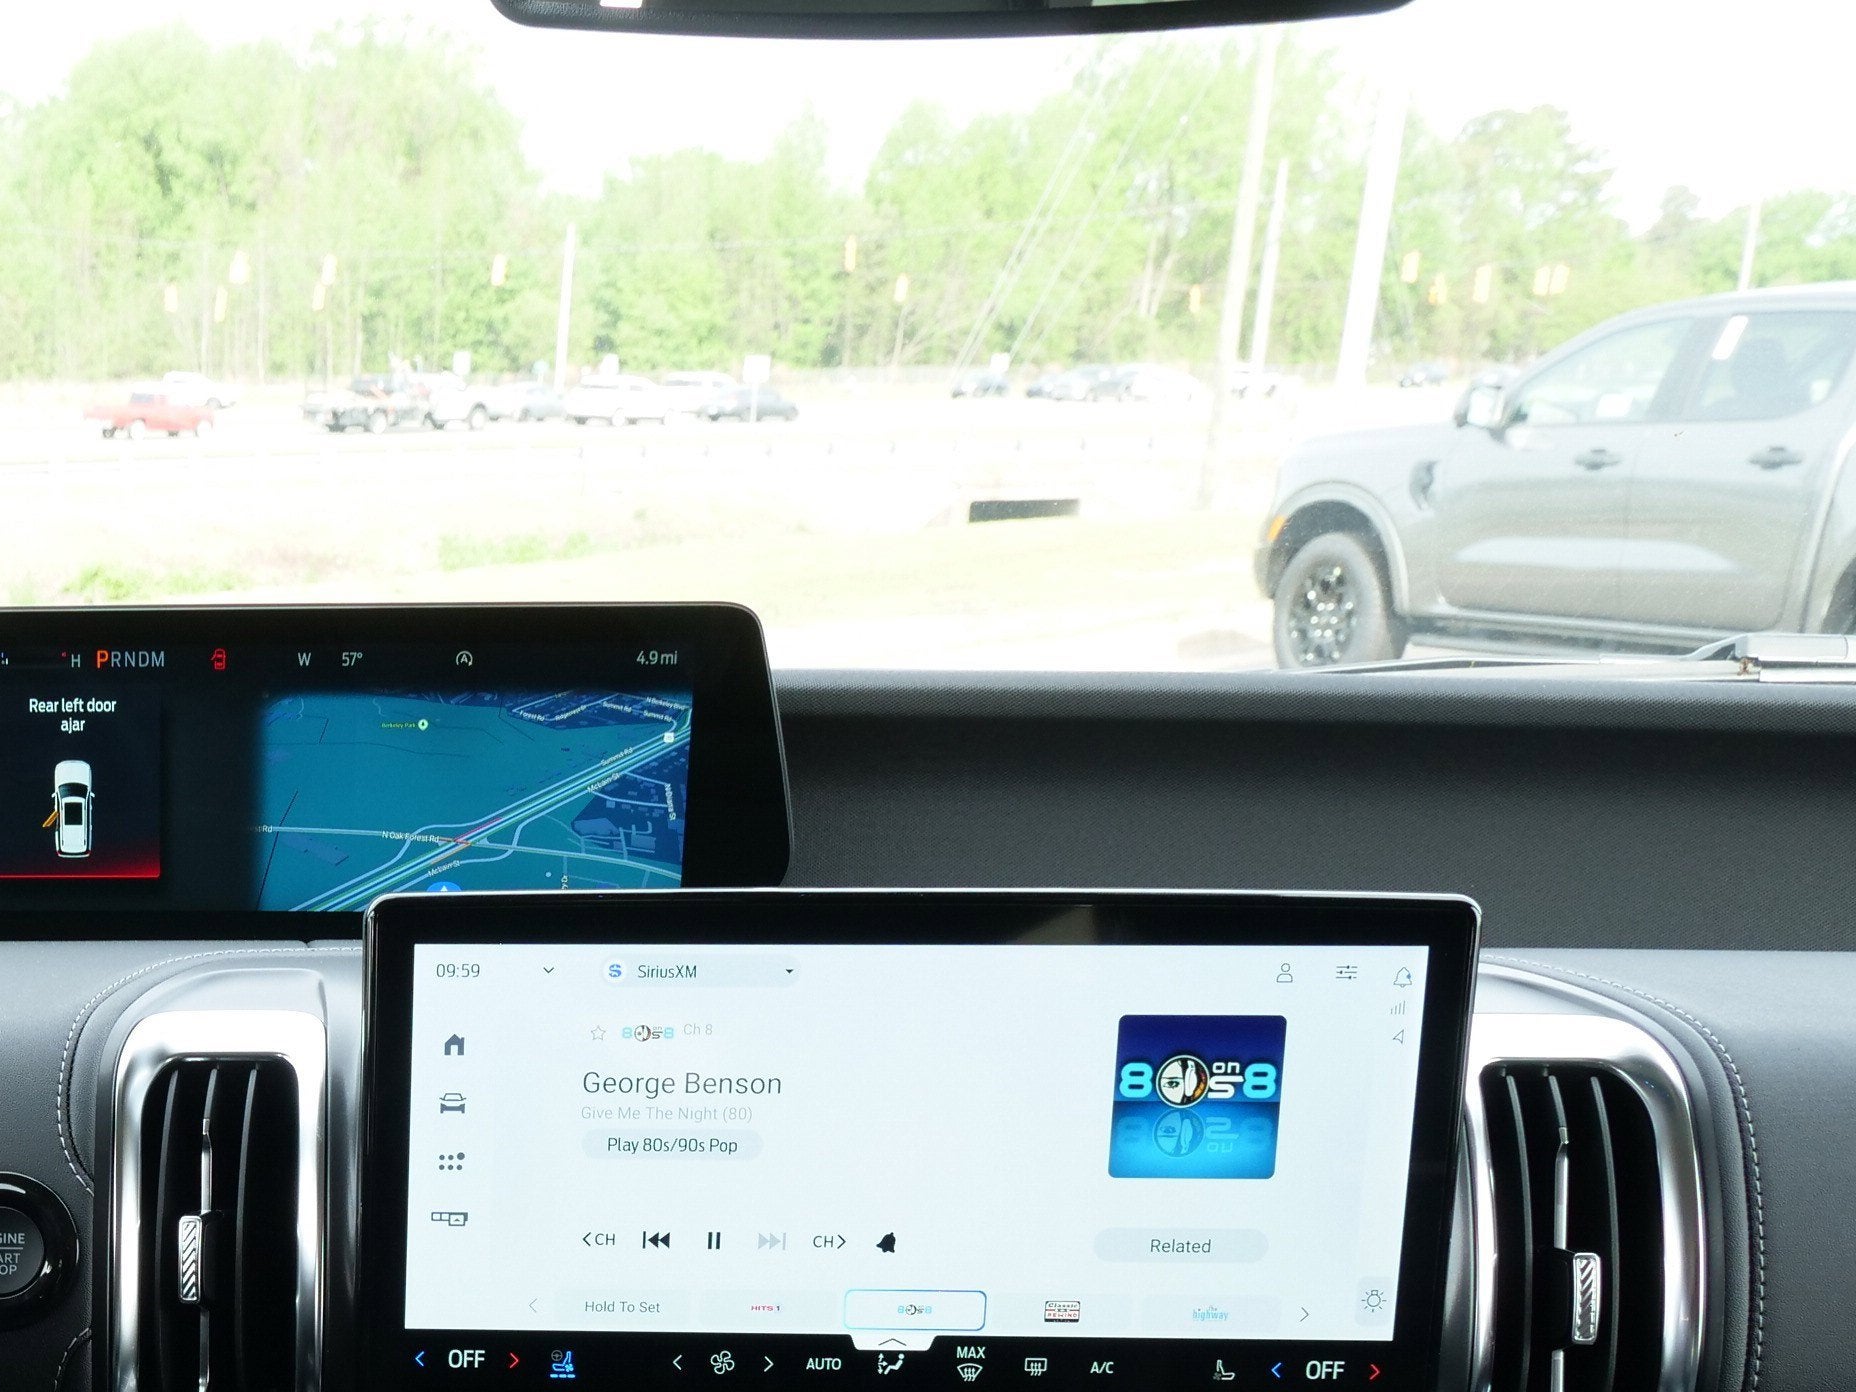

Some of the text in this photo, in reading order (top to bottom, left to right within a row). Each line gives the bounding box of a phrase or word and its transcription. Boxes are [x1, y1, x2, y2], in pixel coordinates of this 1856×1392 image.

[71, 654, 81, 668] H
[297, 652, 312, 667] W
[341, 652, 364, 667] 57°
[636, 650, 678, 665] 4.9 mi
[29, 697, 117, 713] Rear left door
[60, 717, 85, 735] ajar
[436, 963, 480, 978] 09:59
[637, 964, 697, 979] SiriusXM
[683, 1023, 713, 1036] Ch 8
[582, 1071, 782, 1100] George Benson
[581, 1106, 753, 1124] Give Me The Night (80)
[607, 1137, 738, 1156] Play 80s/90s Pop
[595, 1232, 616, 1246] CH
[812, 1235, 834, 1249] CH
[1150, 1238, 1211, 1254] Related
[584, 1300, 661, 1314] Hold To Set
[1193, 1309, 1228, 1321] highway
[448, 1349, 486, 1369] OFF
[956, 1345, 986, 1360] MAX
[805, 1357, 842, 1371] AUTO
[1090, 1361, 1114, 1374] A/C
[1305, 1360, 1346, 1380] OFF
